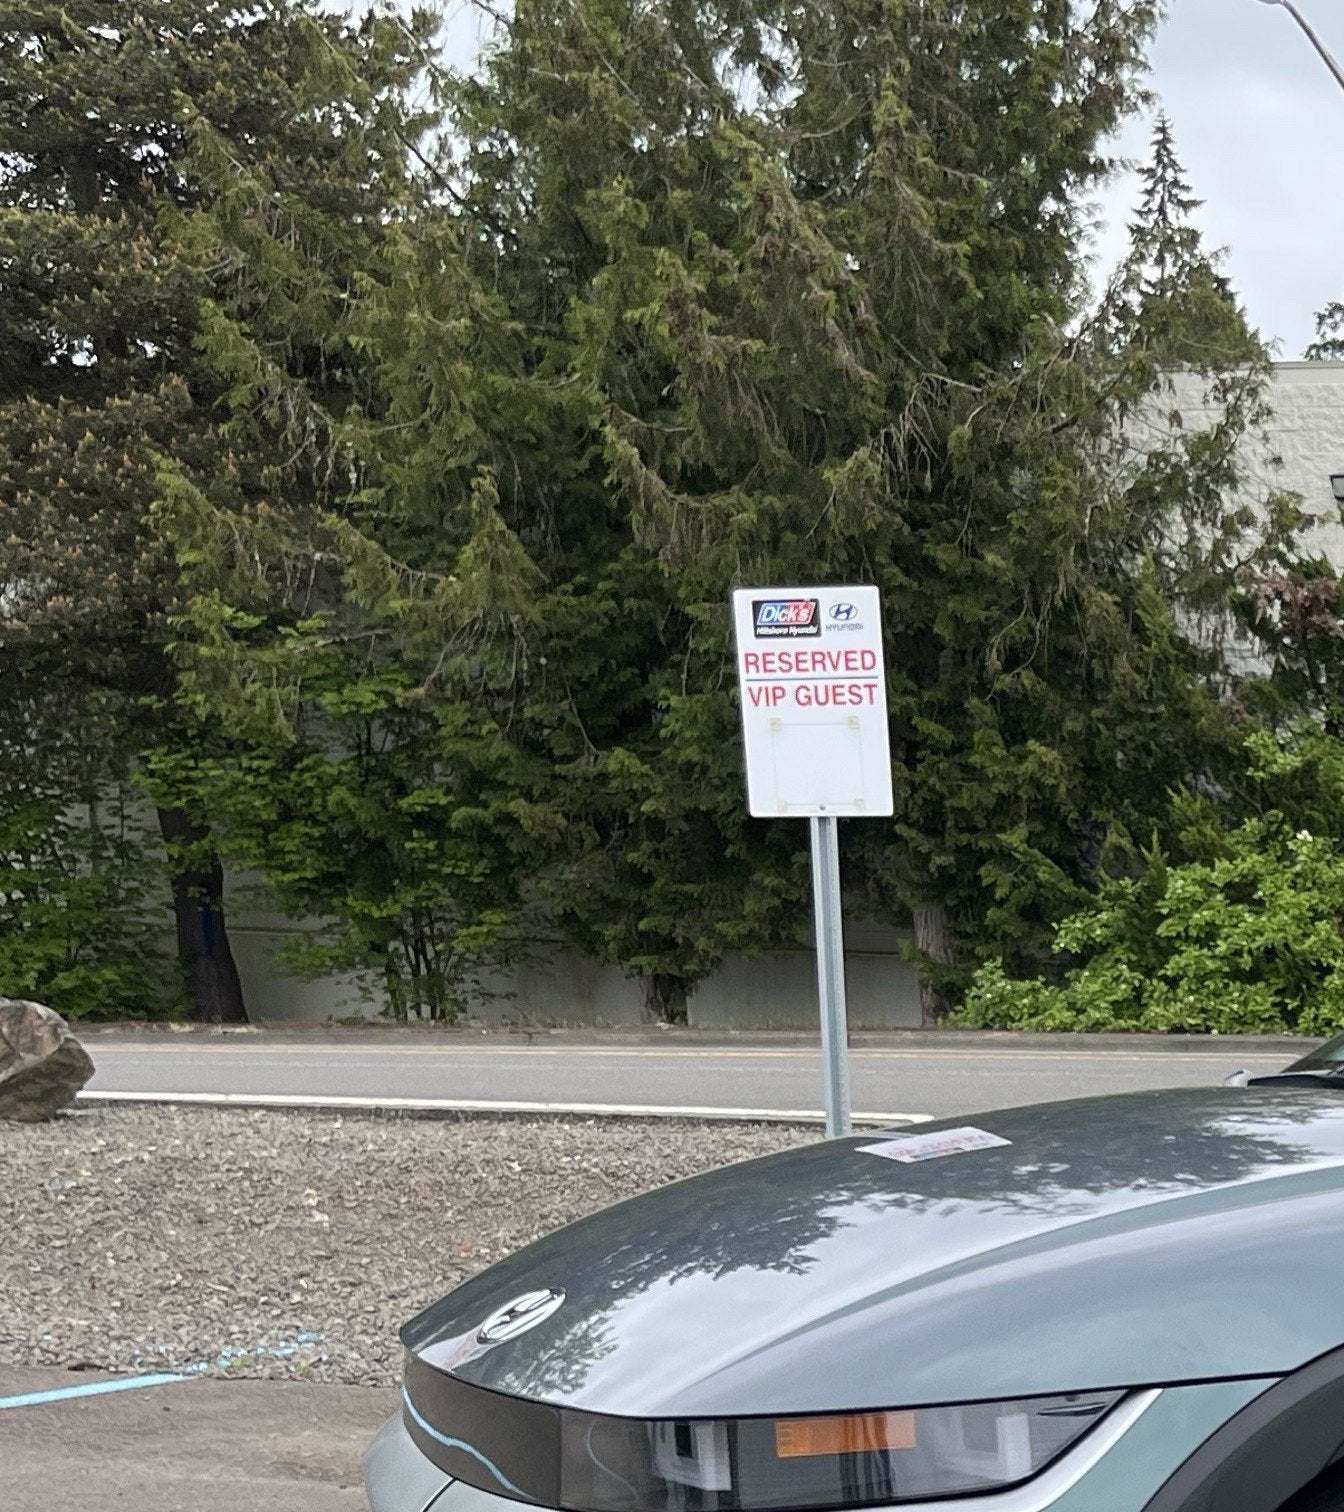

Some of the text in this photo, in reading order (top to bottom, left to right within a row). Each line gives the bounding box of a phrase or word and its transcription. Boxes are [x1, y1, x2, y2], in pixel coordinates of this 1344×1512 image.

[744, 649, 877, 674] RESERVED
[747, 683, 879, 707] VIP GUEST
